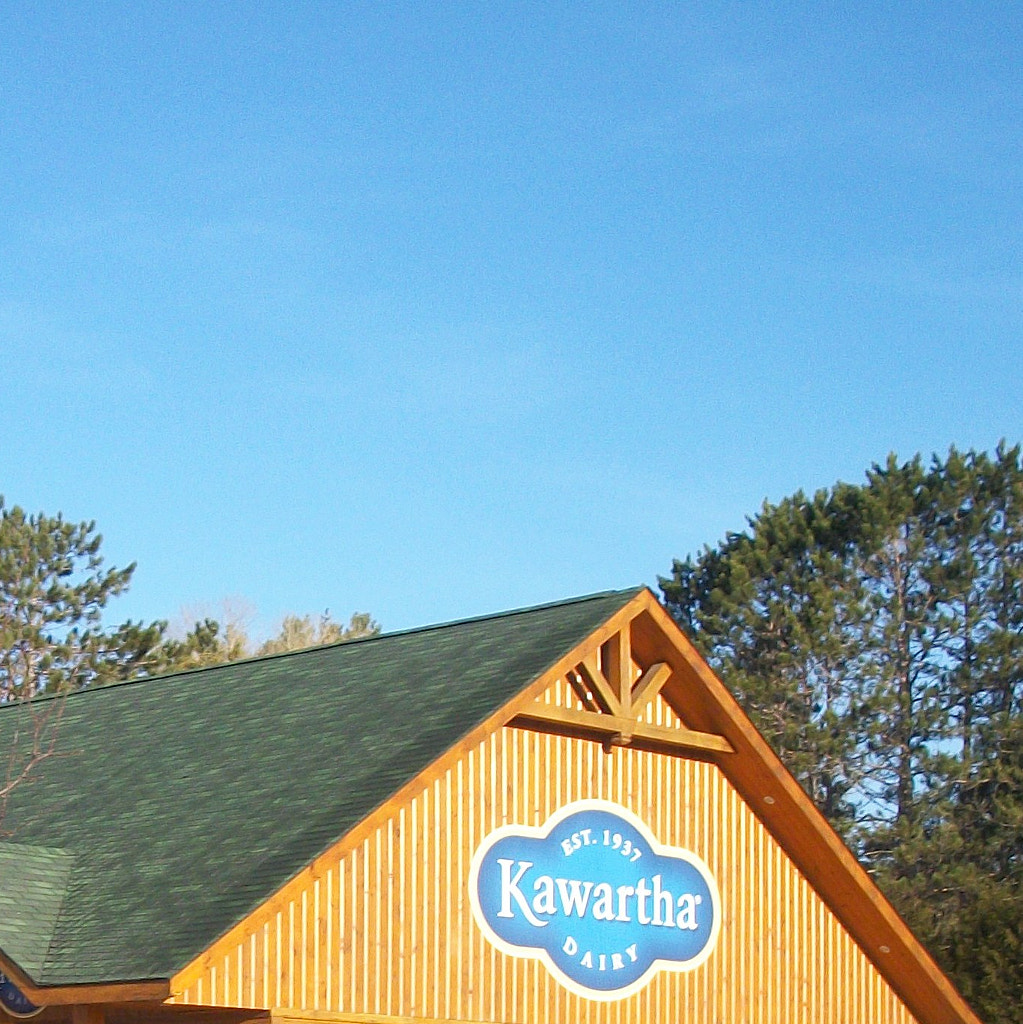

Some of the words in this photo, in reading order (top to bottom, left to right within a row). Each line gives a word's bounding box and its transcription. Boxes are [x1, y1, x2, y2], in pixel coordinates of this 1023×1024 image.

[561, 829, 597, 857] EST.
[603, 829, 642, 862] 1937
[496, 858, 702, 931] Kawartha
[562, 936, 639, 971] DAIRY
